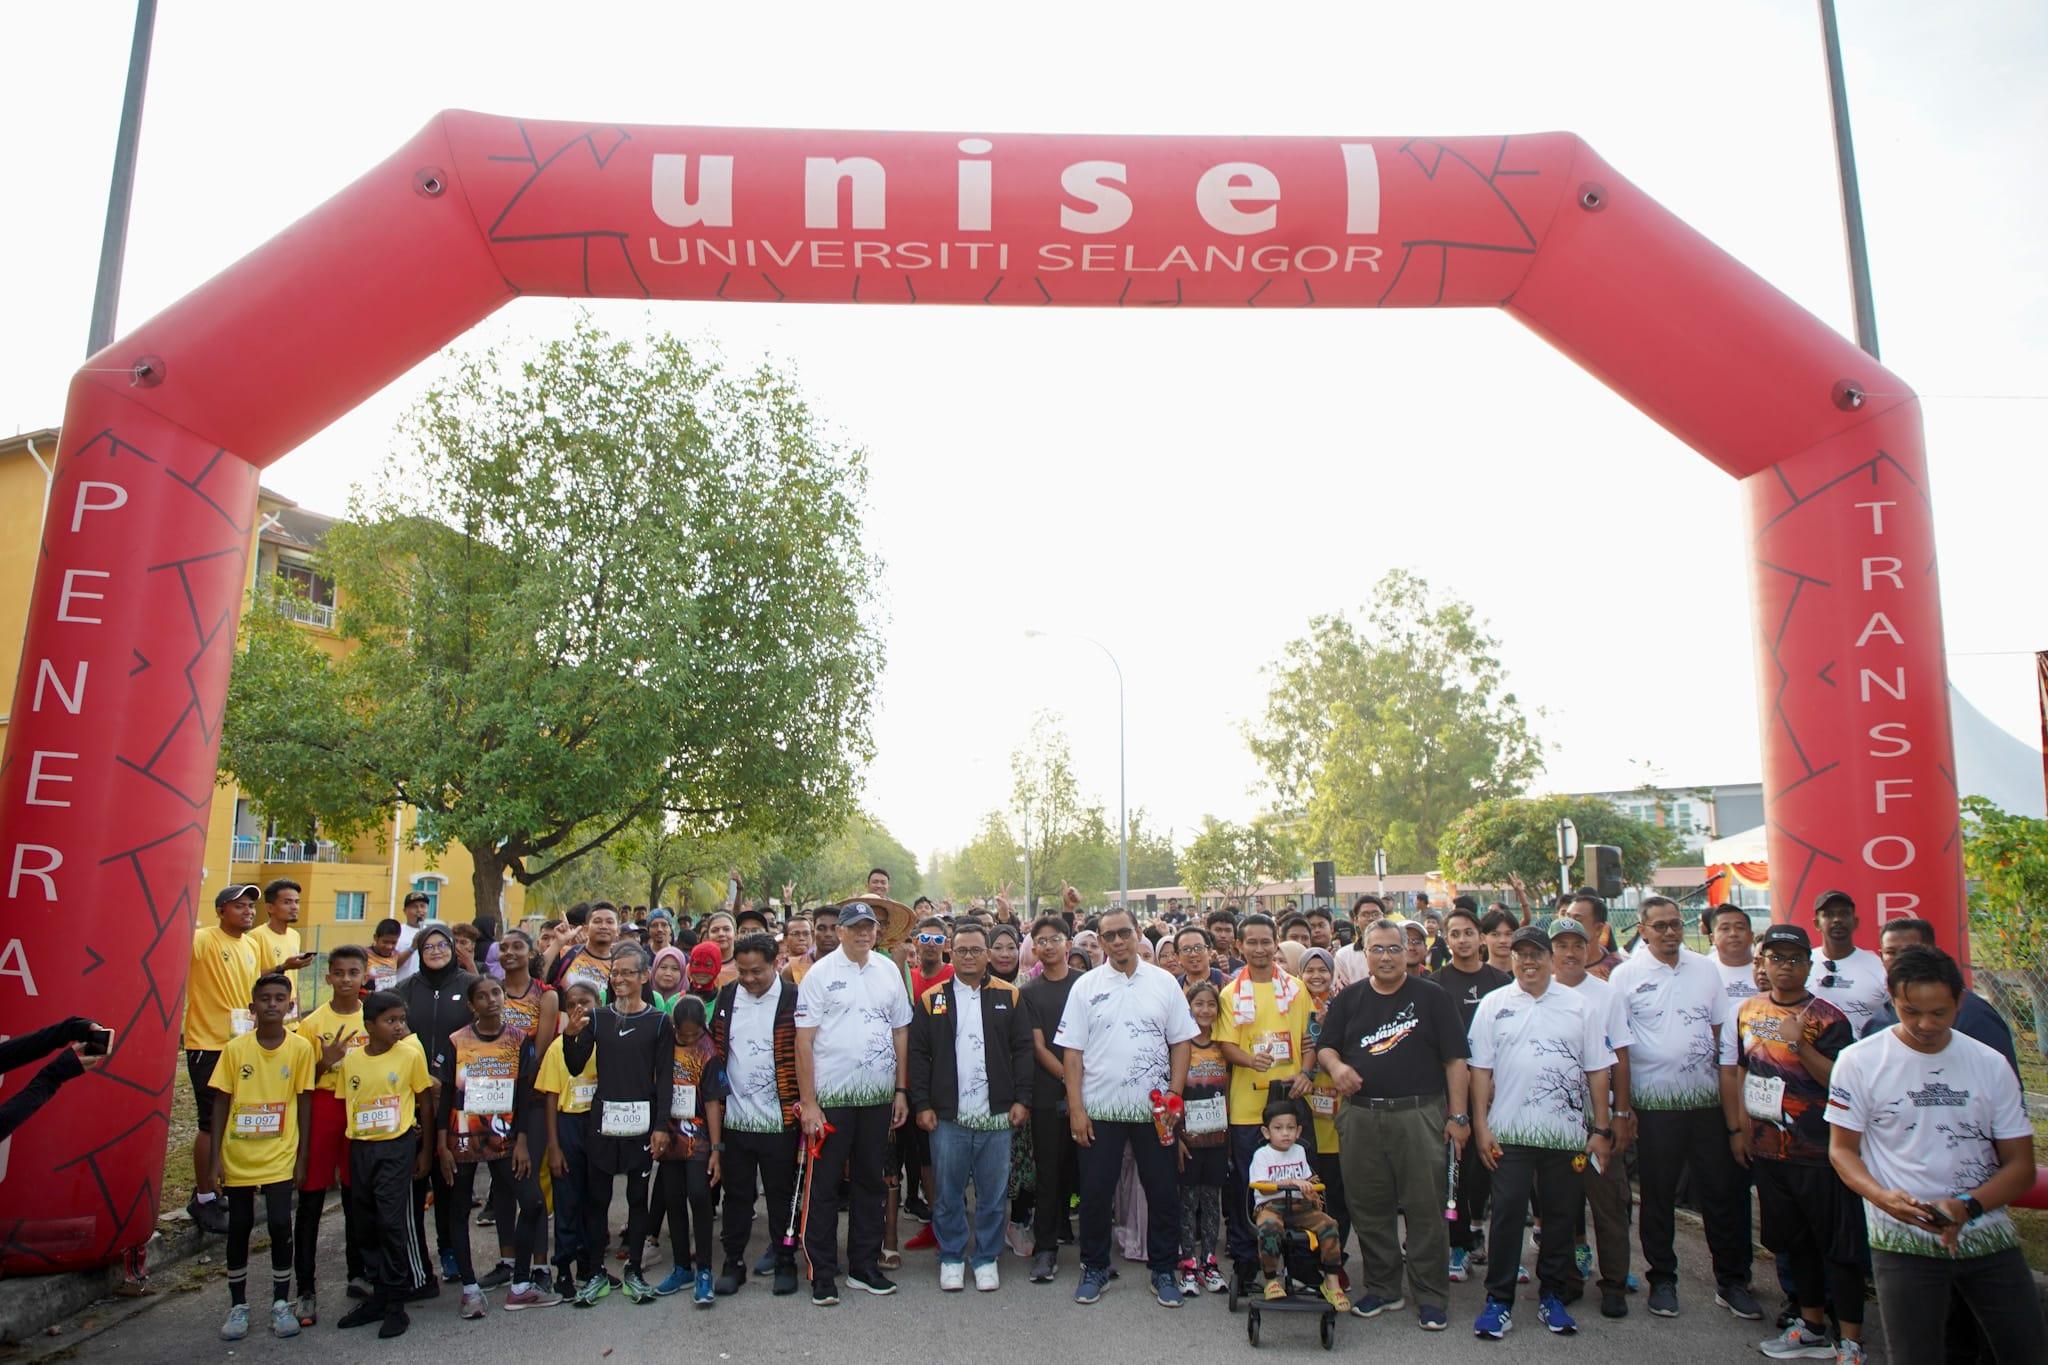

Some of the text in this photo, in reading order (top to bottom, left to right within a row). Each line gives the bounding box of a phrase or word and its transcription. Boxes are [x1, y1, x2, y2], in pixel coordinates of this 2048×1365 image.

[651, 138, 1381, 235] unisel
[649, 237, 1383, 273] UNIVERSITI SELANGOR
[0, 480, 128, 1184] PENERA
[1360, 1018, 1419, 1048] Selangor
[487, 1091, 504, 1101] 004
[244, 1115, 275, 1125] B 097
[362, 1110, 389, 1122] B 081
[613, 1114, 641, 1123] A 009
[1196, 1112, 1204, 1121] A
